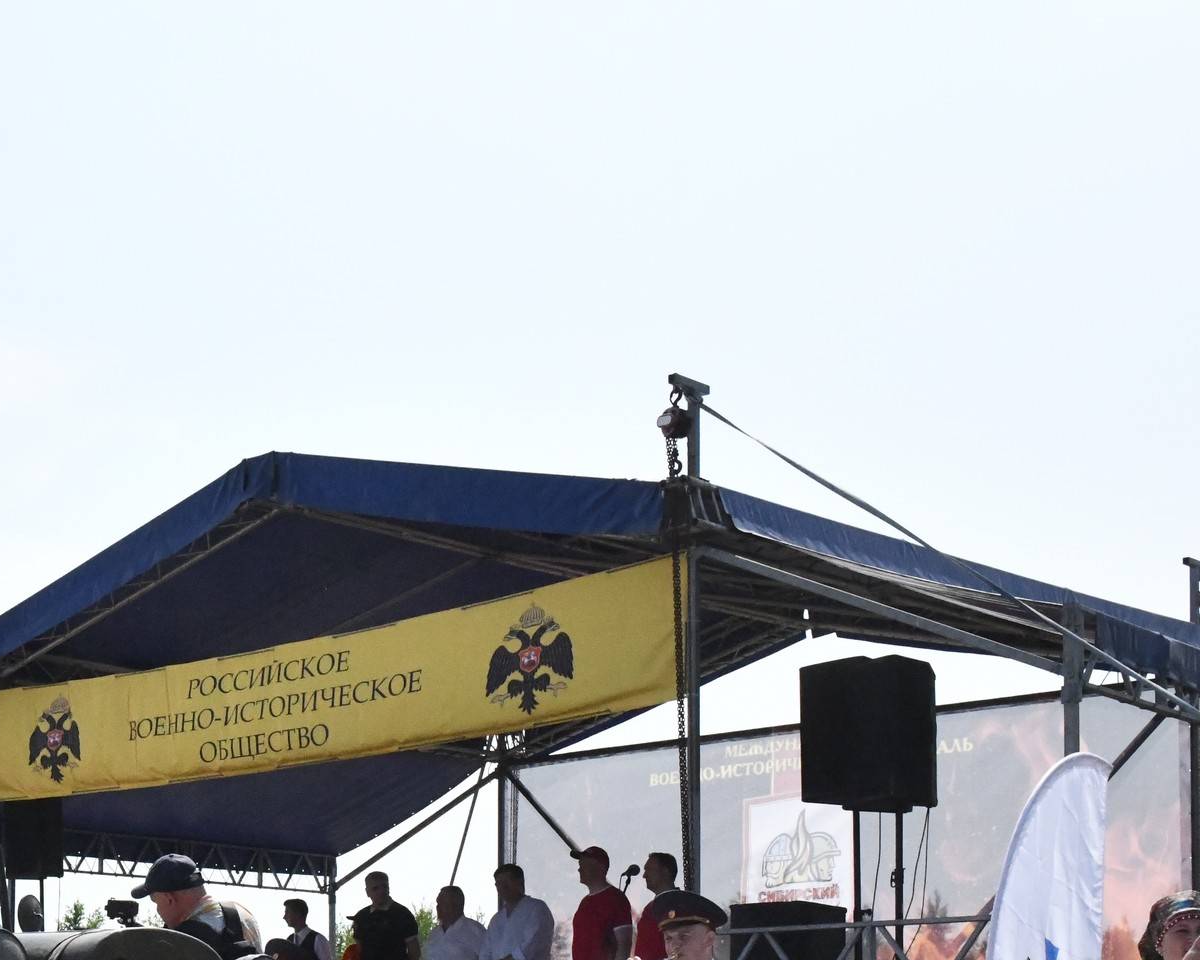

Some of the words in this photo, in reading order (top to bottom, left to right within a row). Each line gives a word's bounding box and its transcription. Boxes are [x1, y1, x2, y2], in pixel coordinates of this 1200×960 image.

[187, 649, 351, 699] РОССИЙСКОЕ
[128, 669, 423, 741] ВОЕННО-ИСТОРИЧЕСКОЕ
[199, 723, 330, 763] ОБЩЕСТВО
